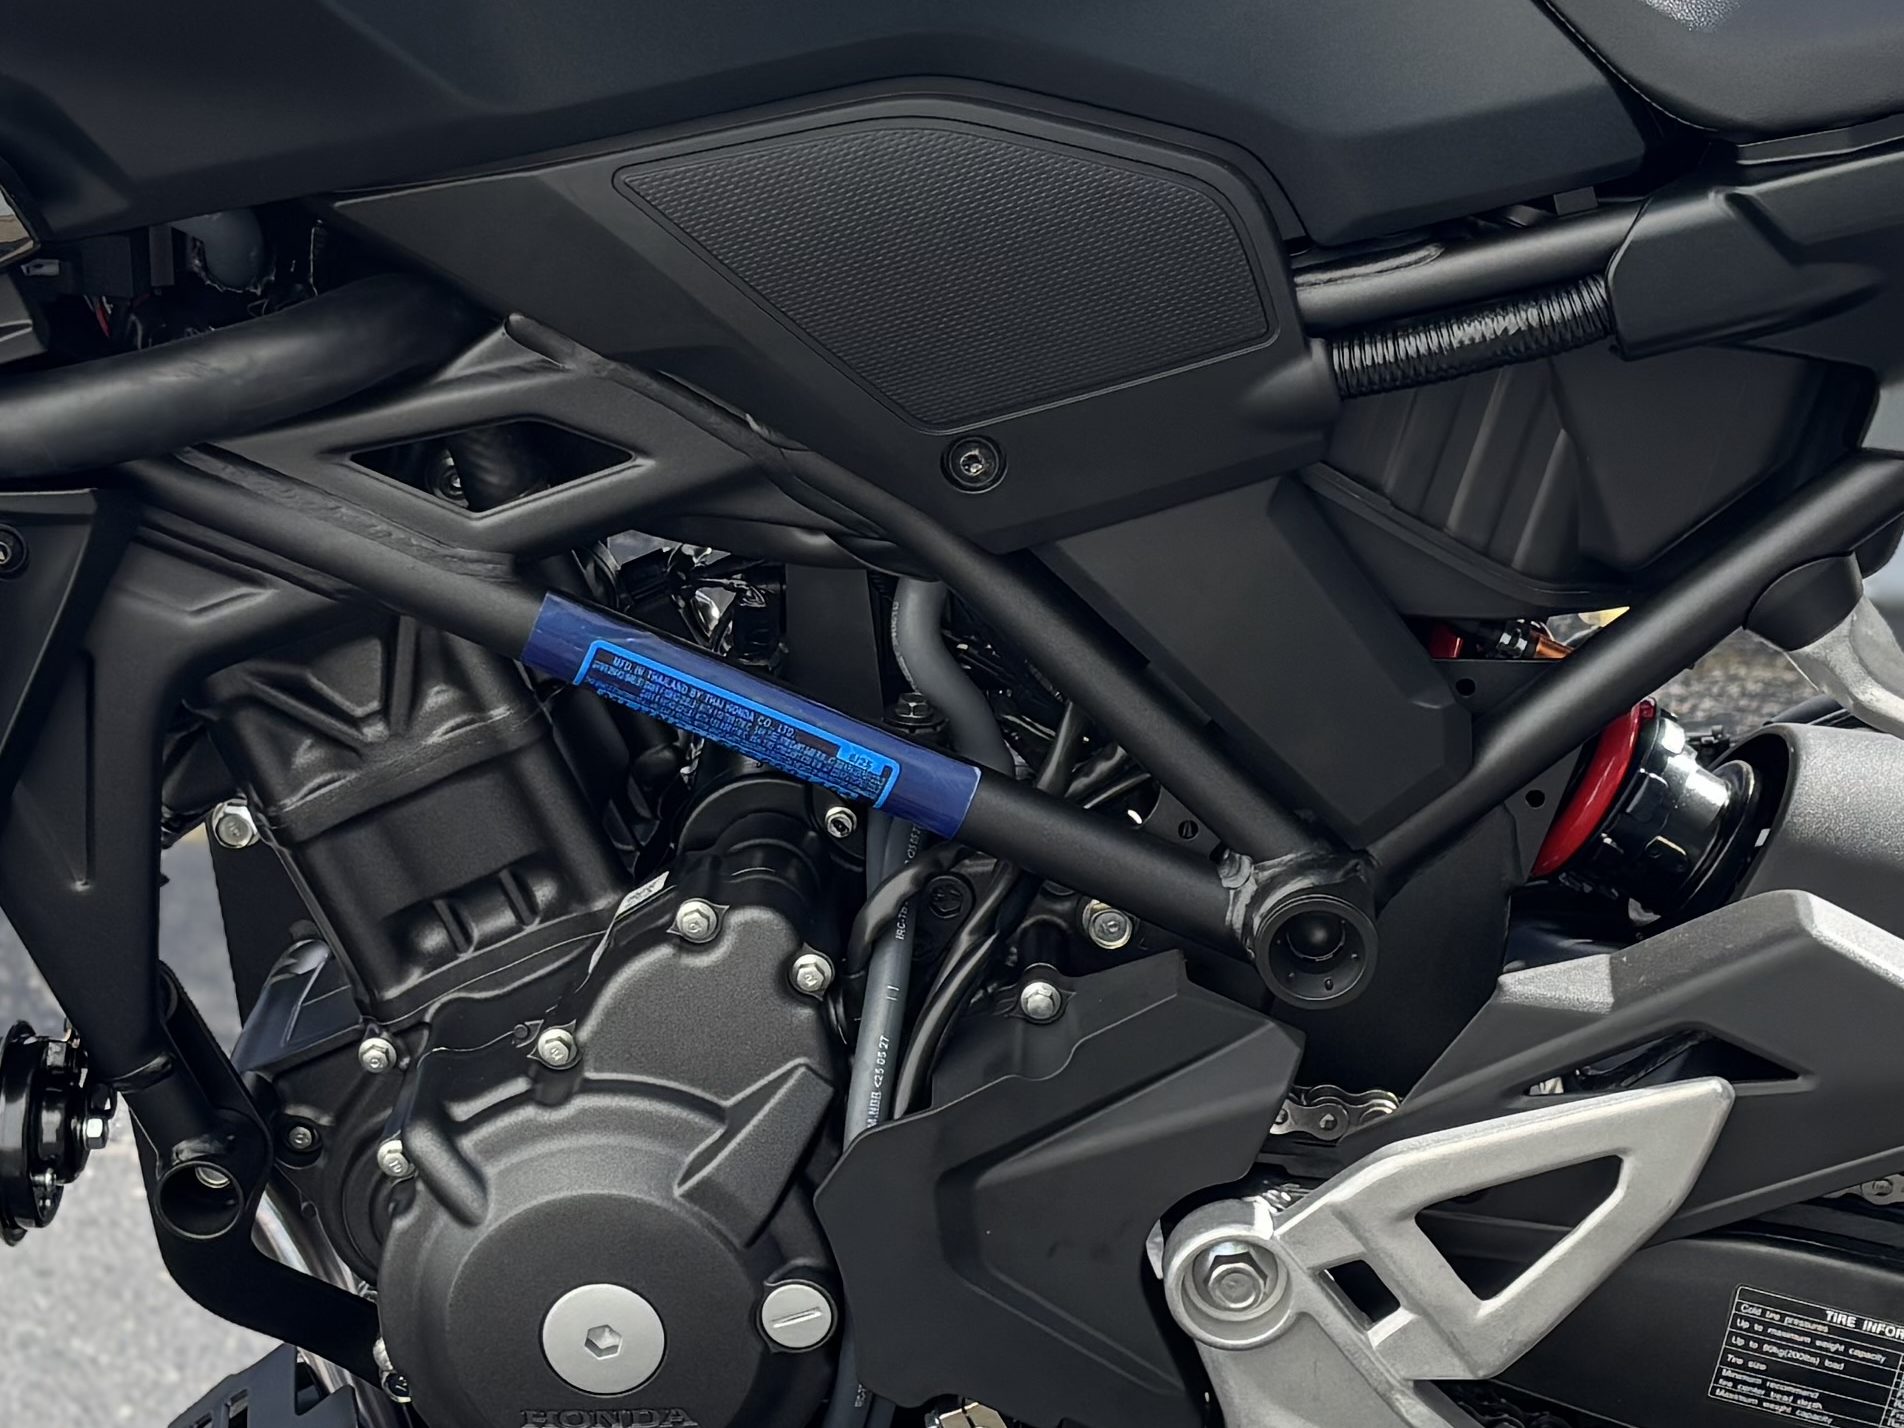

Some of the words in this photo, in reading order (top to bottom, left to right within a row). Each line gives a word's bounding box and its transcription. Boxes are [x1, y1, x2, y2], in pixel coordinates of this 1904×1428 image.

[690, 687, 702, 699] BY
[726, 701, 755, 723] HONDA
[1740, 1303, 1762, 1316] Cold
[1766, 1310, 1781, 1321] tire
[1825, 1310, 1857, 1328] TIRE
[1731, 1335, 1746, 1347] Up
[1749, 1340, 1759, 1349] to
[1824, 1358, 1845, 1371] load
[1736, 1318, 1750, 1330] Up
[1754, 1323, 1764, 1332] to
[1767, 1327, 1812, 1344] maximum
[1815, 1339, 1845, 1353] weight
[1849, 1347, 1887, 1364] capacity
[1721, 1368, 1762, 1385] Minimum
[1726, 1353, 1744, 1365] Tire
[1748, 1359, 1767, 1371] size
[1715, 1388, 1758, 1405] Maximum
[1762, 1401, 1792, 1414] weight
[1795, 1410, 1834, 1425] capacity
[1718, 1378, 1734, 1388] tire
[1737, 1384, 1765, 1396] center
[1770, 1390, 1794, 1404] tread
[1796, 1398, 1823, 1410] depth
